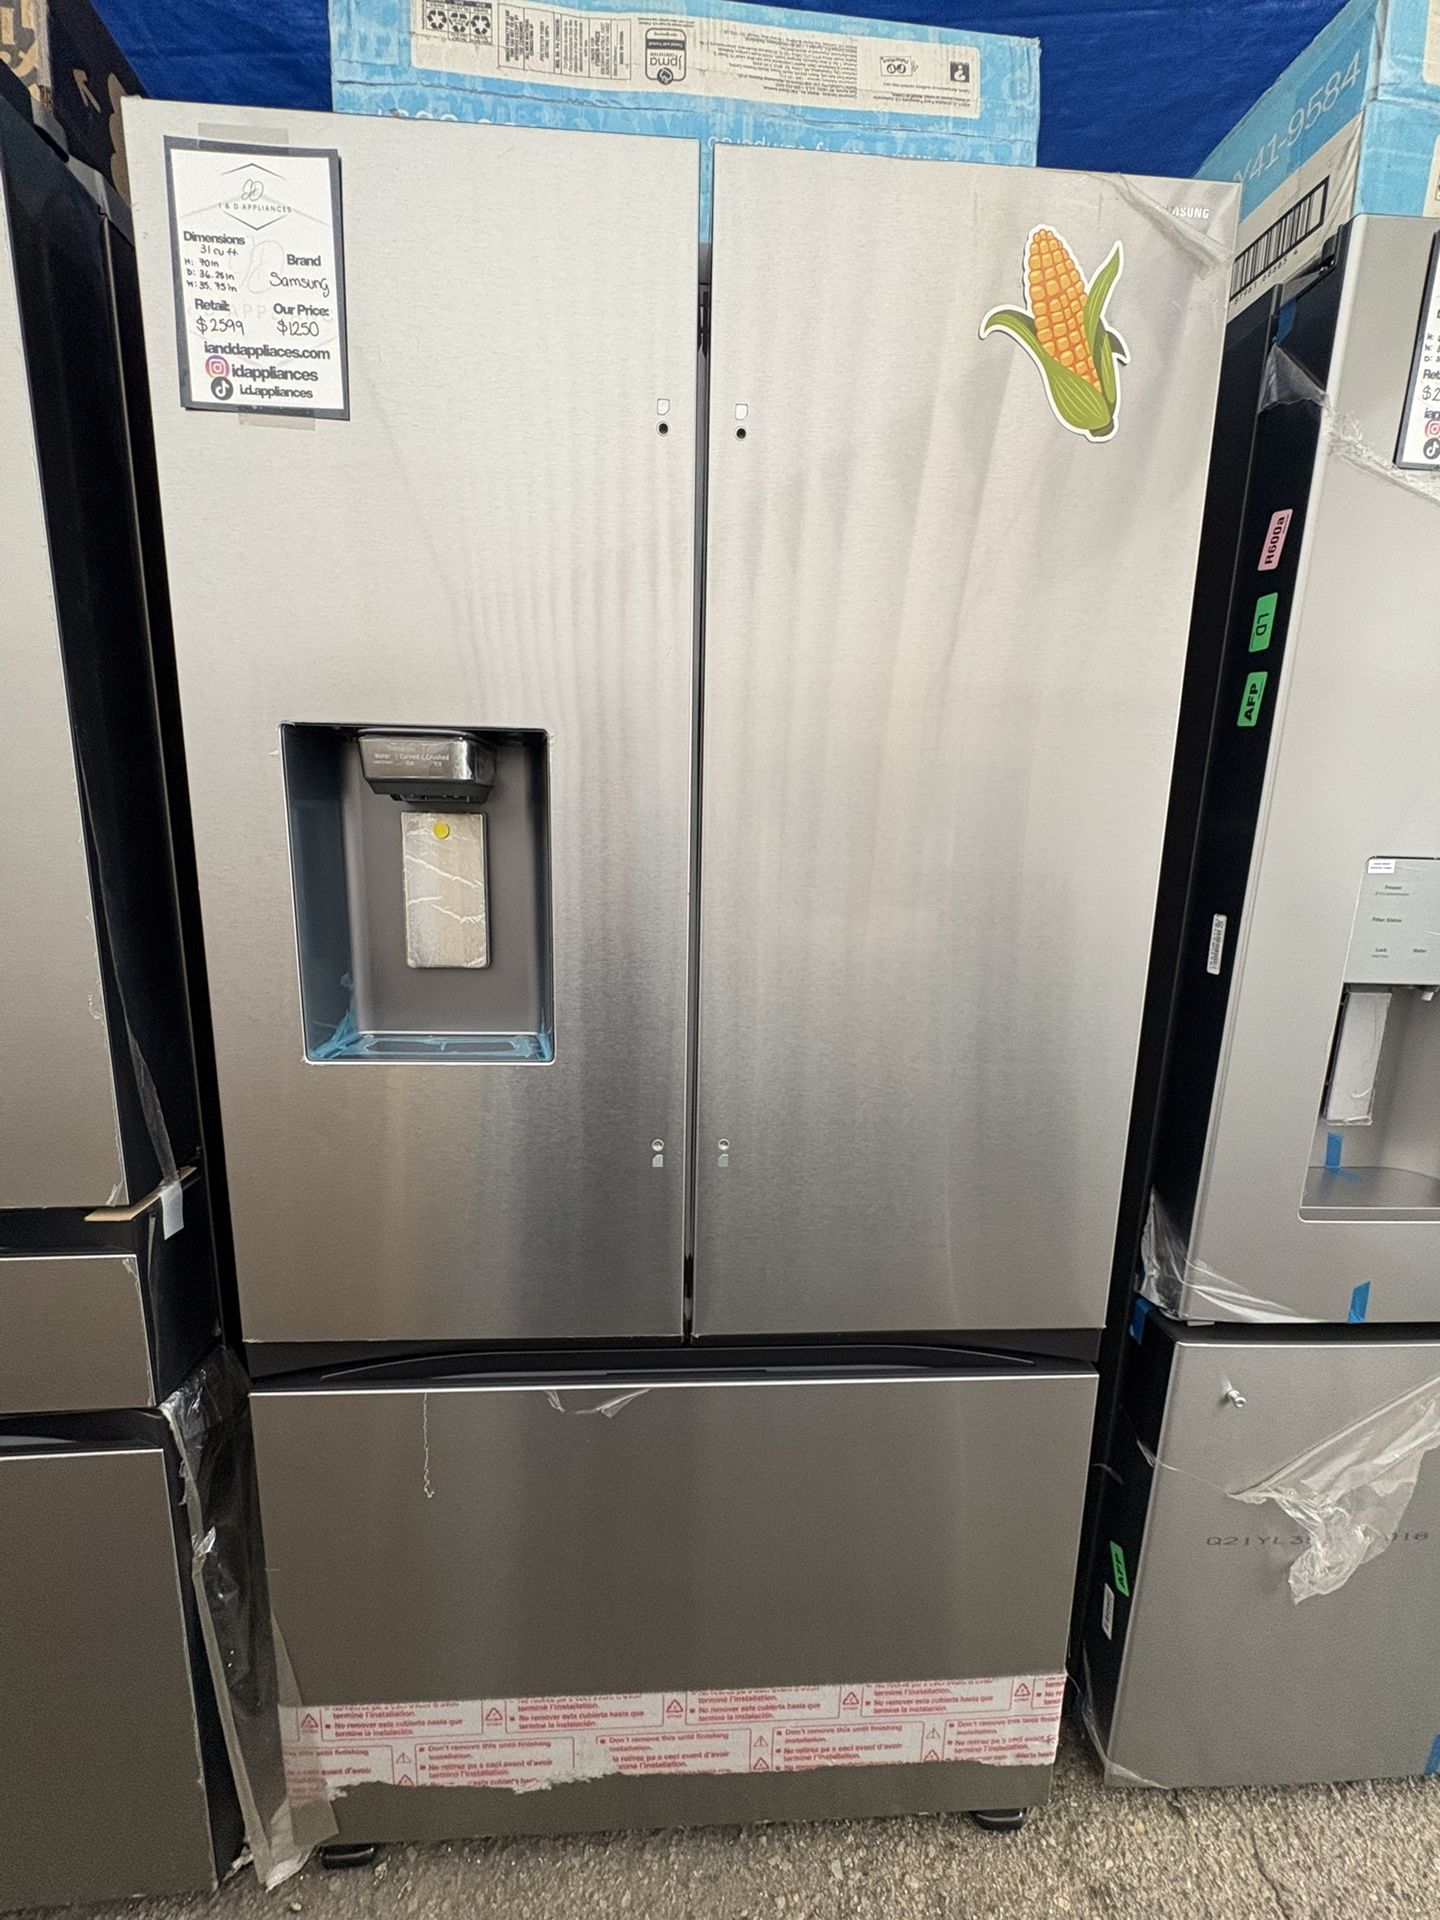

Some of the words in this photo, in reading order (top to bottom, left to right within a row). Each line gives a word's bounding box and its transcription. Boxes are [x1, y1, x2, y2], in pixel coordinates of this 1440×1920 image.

[241, 203, 292, 213] APPLIANCES
[183, 230, 246, 246] Dimensions
[200, 244, 212, 255] 31
[286, 254, 321, 267] Brand
[186, 268, 197, 277] D:
[269, 271, 330, 298] Samsung
[194, 298, 231, 312] Retail:
[273, 302, 296, 315] Our
[297, 303, 330, 317] Price:
[276, 318, 320, 337] $1250
[203, 341, 331, 360] ianddappliaces.com
[231, 364, 319, 383] idappliances
[1264, 516, 1285, 565] R600a
[1255, 612, 1270, 637] LD
[1244, 681, 1260, 722] AFP
[980, 1695, 994, 1703] que
[807, 1702, 821, 1711] que
[630, 1710, 645, 1719] que
[449, 1719, 463, 1727] que
